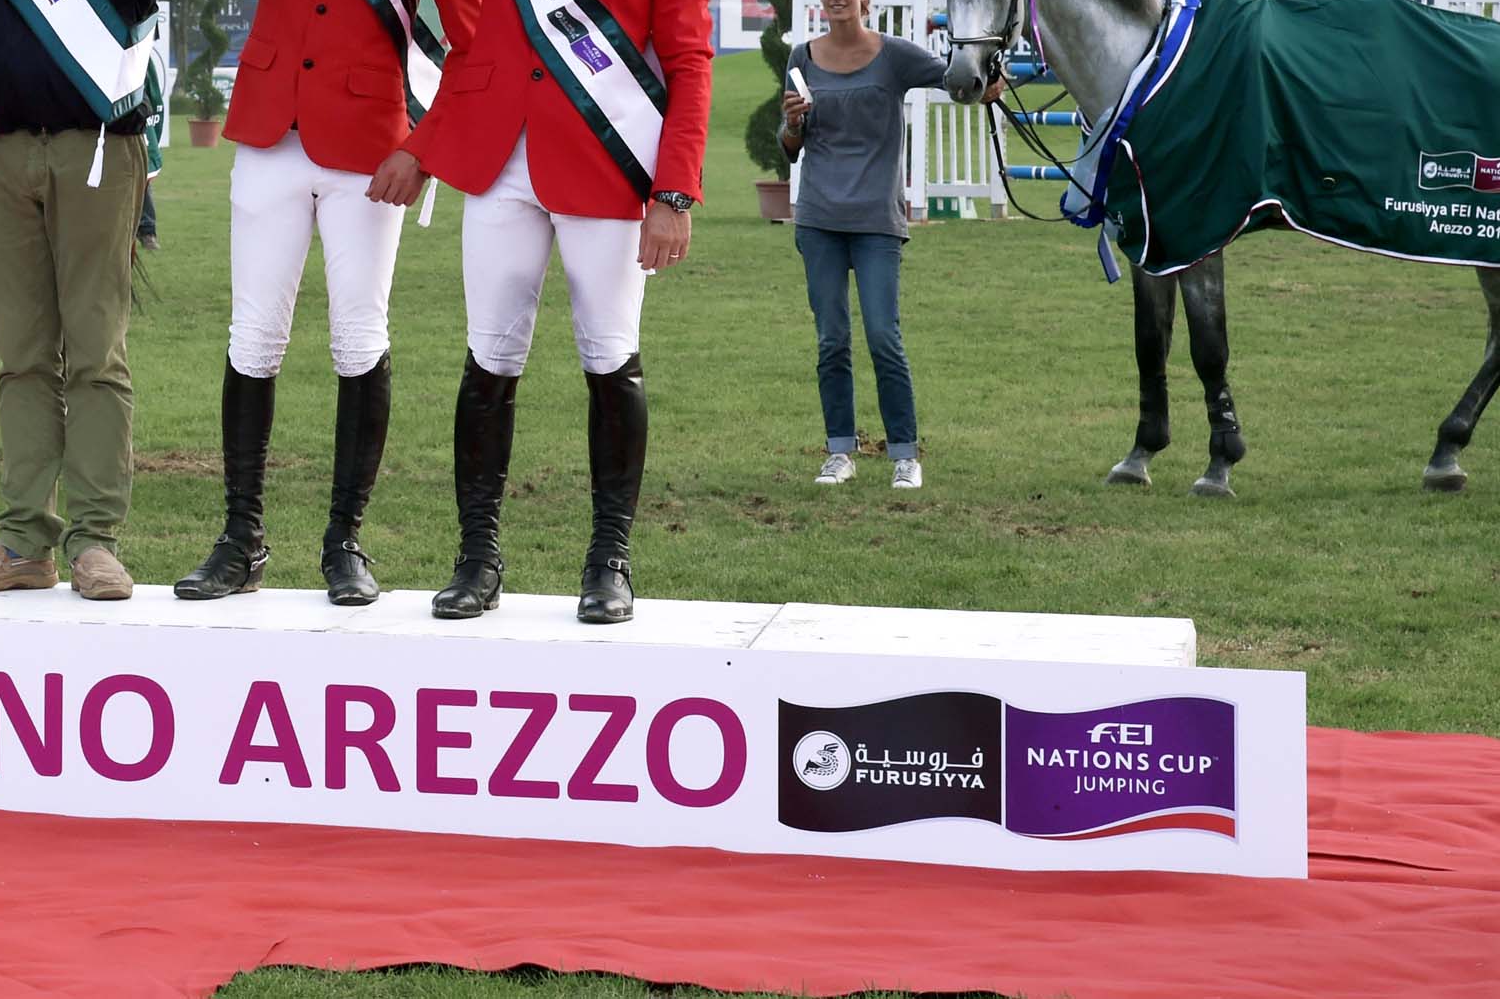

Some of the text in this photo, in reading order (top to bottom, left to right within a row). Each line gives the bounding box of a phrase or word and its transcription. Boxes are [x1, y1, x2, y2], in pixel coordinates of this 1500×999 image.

[1385, 197, 1447, 218] Furusiyya
[1451, 204, 1471, 218] FEI
[1429, 220, 1472, 236] Arezzo
[219, 680, 748, 808] AREZZO
[1085, 722, 1152, 745] FEI
[855, 743, 984, 769] فروسية
[1027, 747, 1213, 775] NATIONS CUP
[855, 768, 985, 790] FURUSIYYA
[1074, 775, 1166, 795] JUMPING
